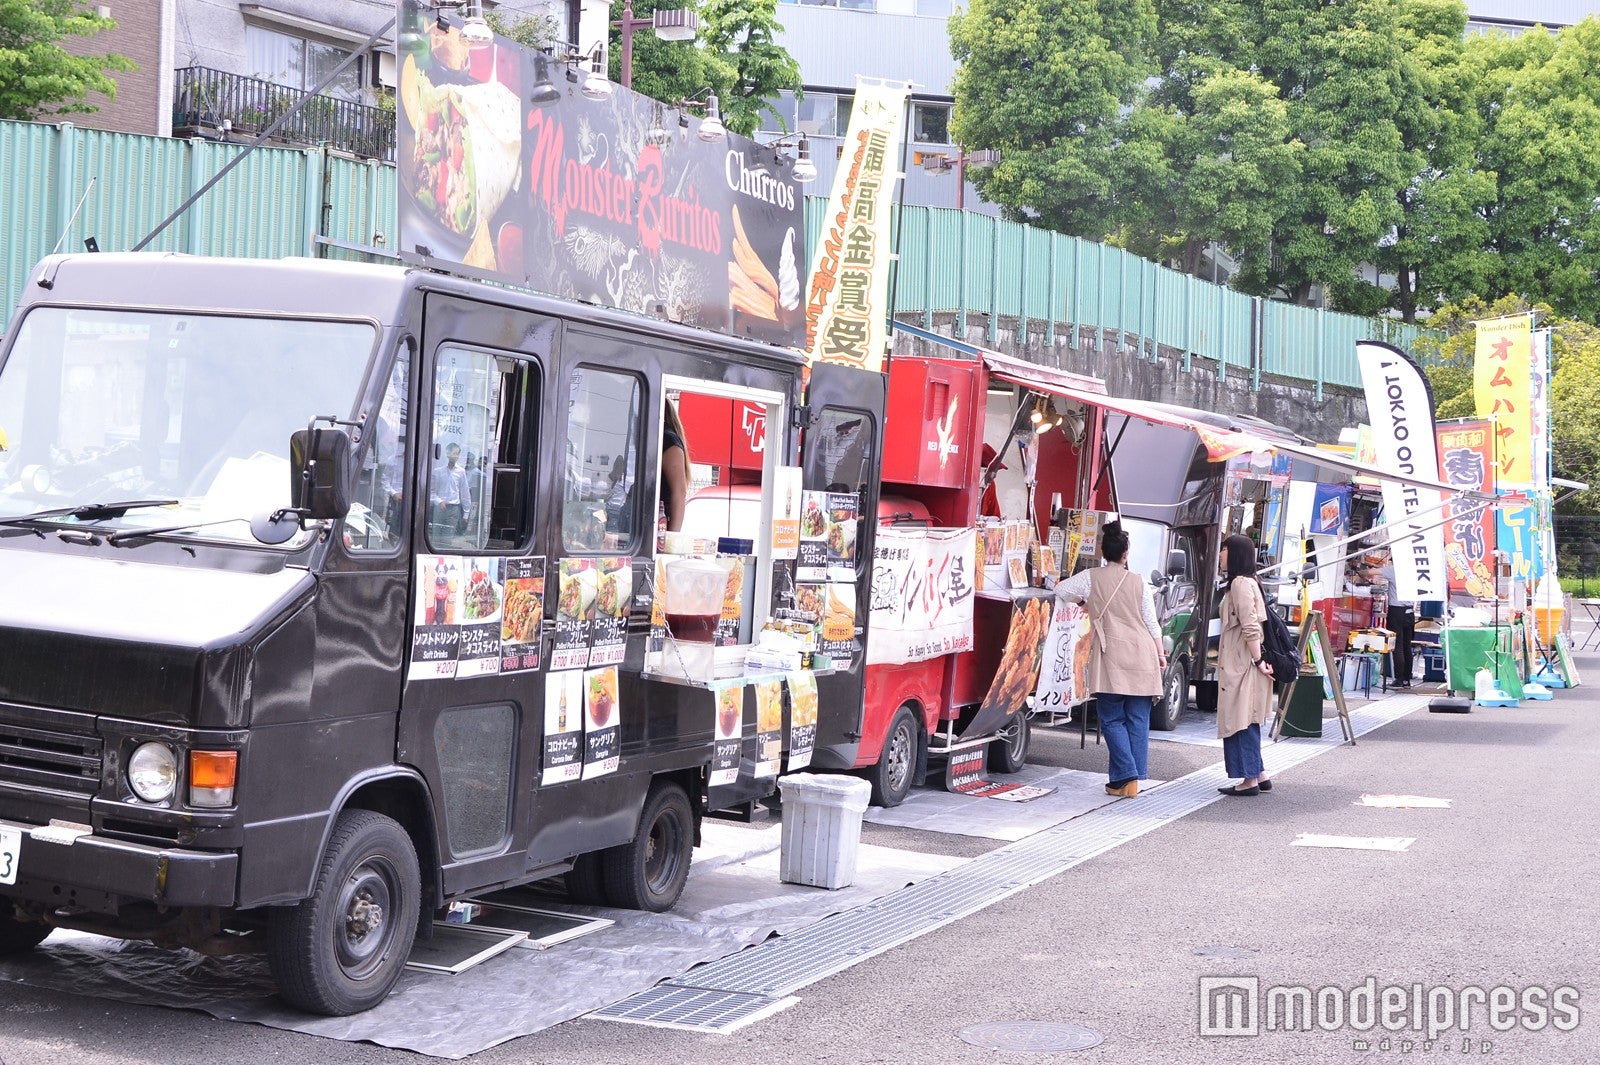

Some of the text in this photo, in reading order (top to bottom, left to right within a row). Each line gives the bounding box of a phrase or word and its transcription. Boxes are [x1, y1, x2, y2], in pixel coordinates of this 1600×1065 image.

[528, 108, 722, 262] Monster Burritos
[726, 149, 795, 211] Churros
[1489, 336, 1515, 475] オムハヤシ
[415, 632, 459, 646] ソフトドリンク
[461, 628, 489, 642] モンスター
[466, 640, 499, 655] タコスライス
[436, 661, 456, 674] ¥200
[547, 737, 578, 753] コロナビール
[589, 732, 616, 748] サングリア
